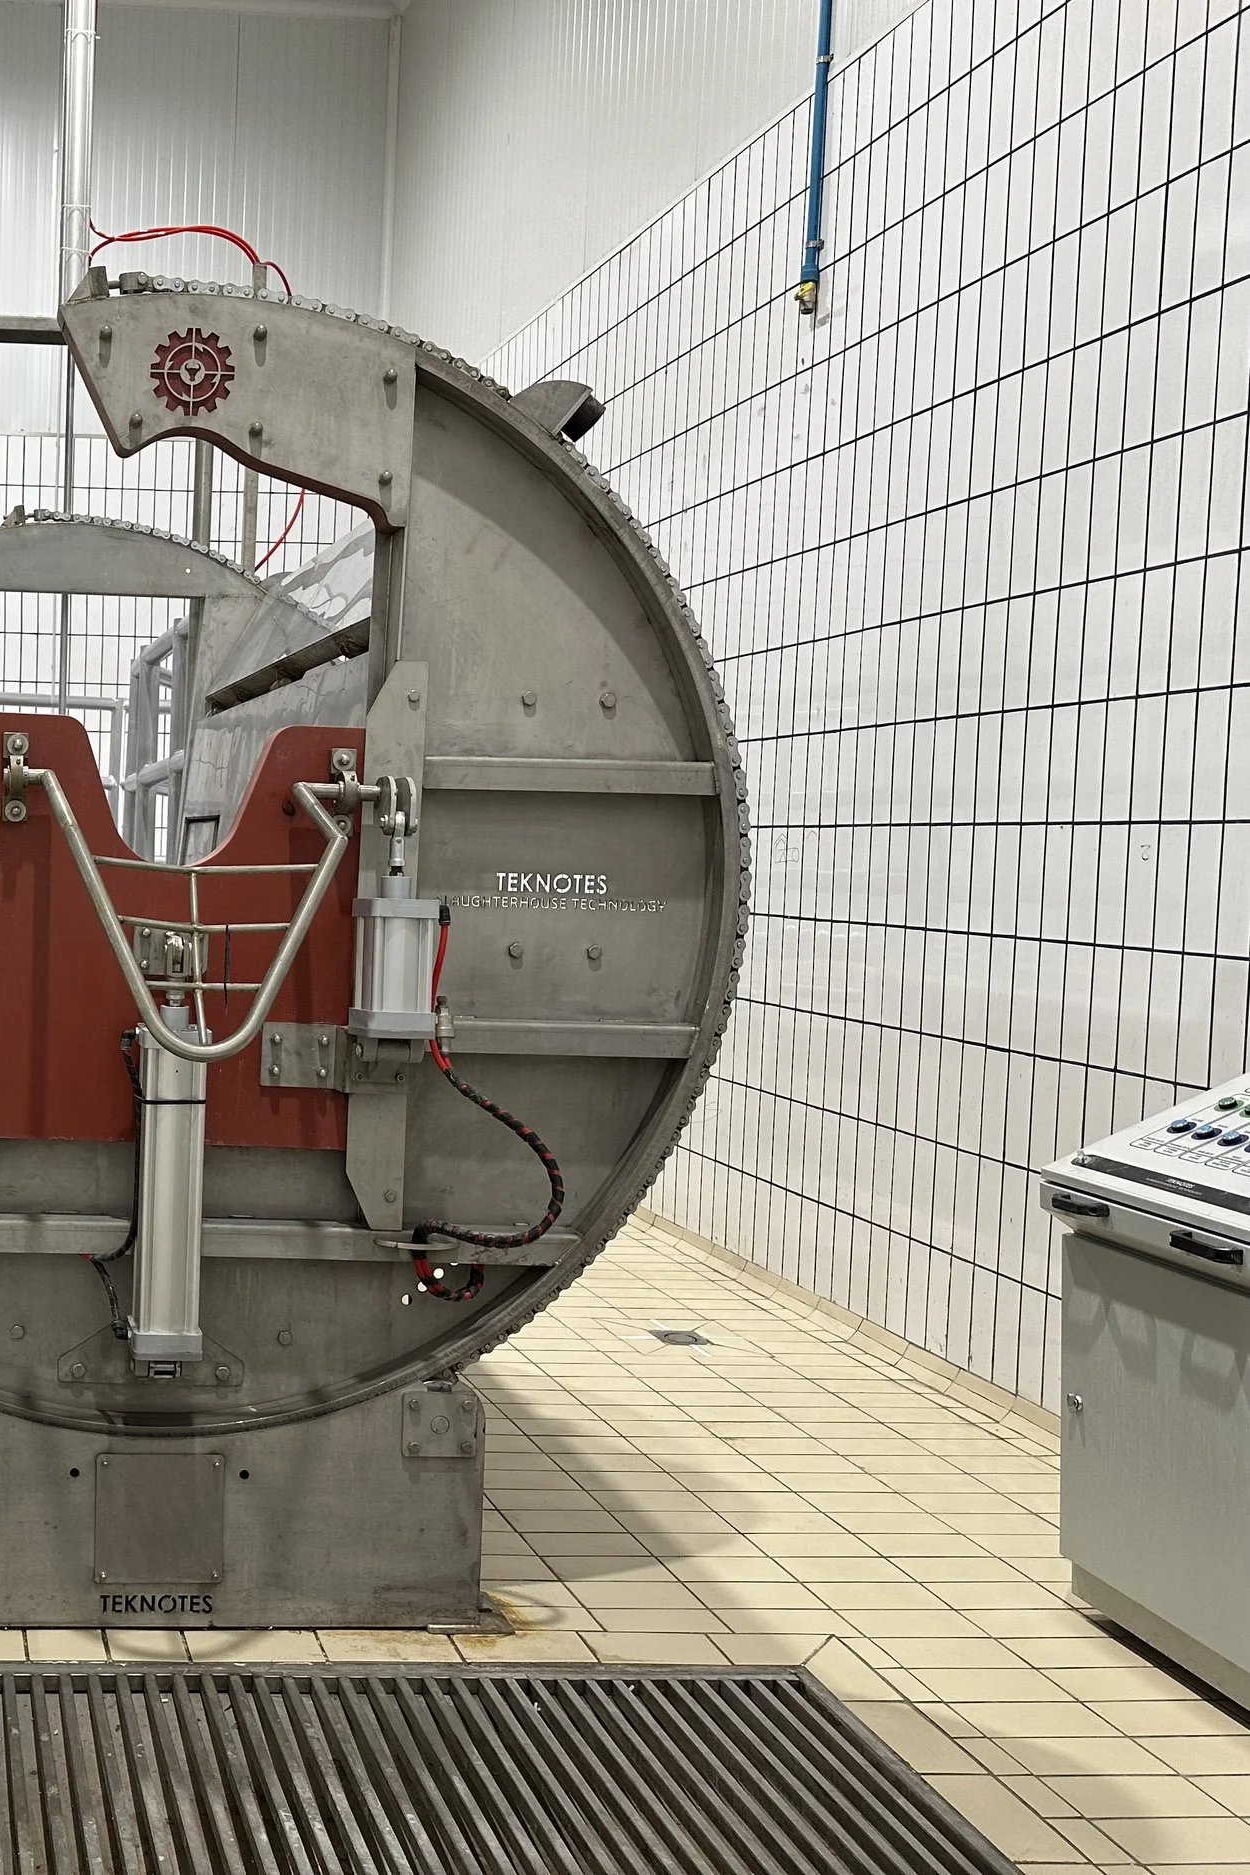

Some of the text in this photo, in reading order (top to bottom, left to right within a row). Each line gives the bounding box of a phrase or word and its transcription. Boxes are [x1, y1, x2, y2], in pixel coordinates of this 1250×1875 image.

[496, 872, 607, 895] TEKNOTES
[571, 898, 666, 912] TECHNOLOGY
[100, 1594, 213, 1614] TEKNOTES
